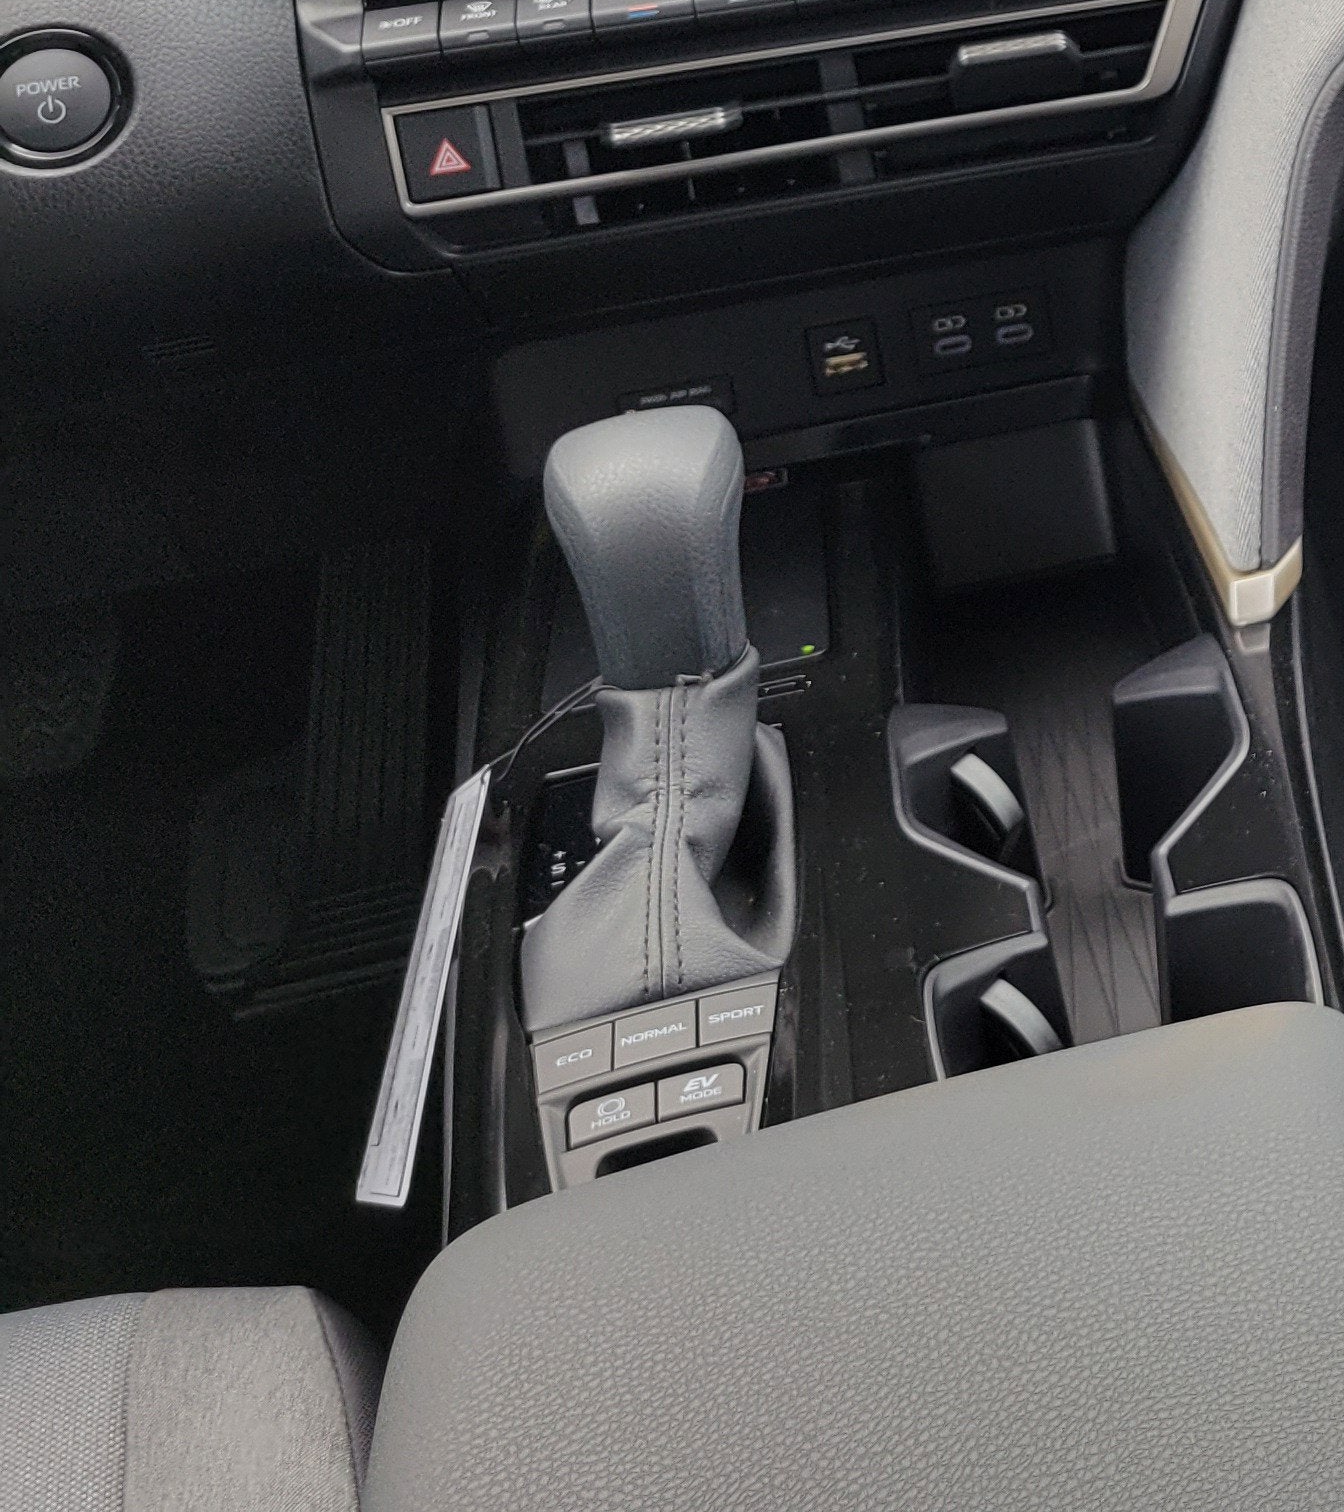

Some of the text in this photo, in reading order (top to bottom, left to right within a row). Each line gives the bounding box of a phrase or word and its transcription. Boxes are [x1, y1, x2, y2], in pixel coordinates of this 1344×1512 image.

[396, 14, 423, 28] OFF
[17, 76, 81, 97] POWER
[550, 862, 567, 876] S
[707, 1004, 765, 1024] SPORT
[620, 1021, 688, 1047] NORMAL
[556, 1048, 593, 1067] ECO
[684, 1072, 721, 1090] EV
[680, 1085, 722, 1104] MODE
[590, 1109, 632, 1131] HOLD
